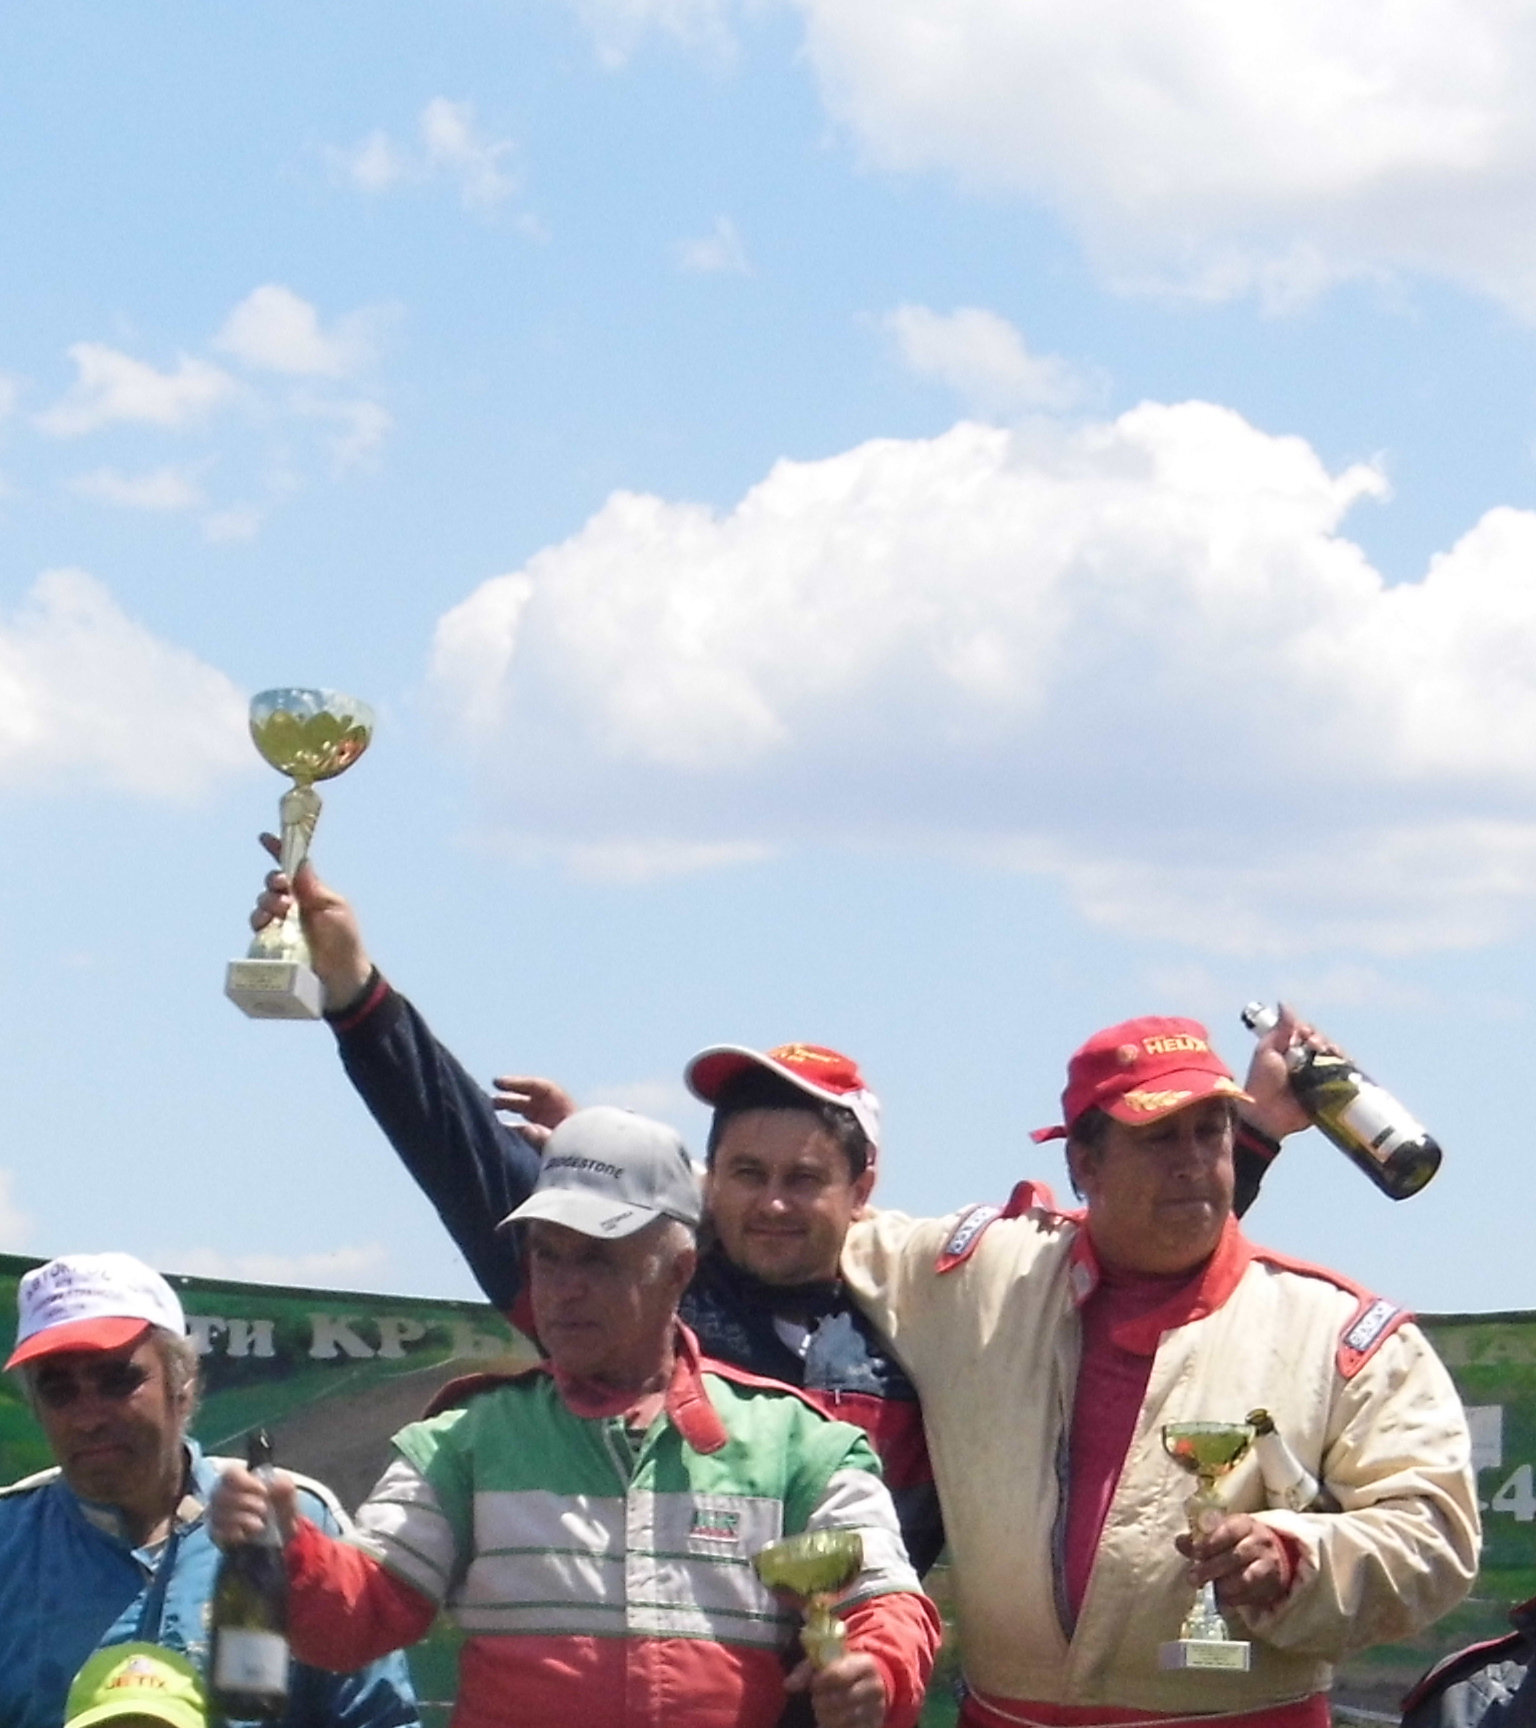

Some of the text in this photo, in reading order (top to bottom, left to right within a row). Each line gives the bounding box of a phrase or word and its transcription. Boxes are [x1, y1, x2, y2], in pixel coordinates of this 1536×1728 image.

[1146, 1036, 1207, 1054] HELIX
[543, 1156, 626, 1179] BRIDGESTONE
[184, 1314, 276, 1358] ТИ
